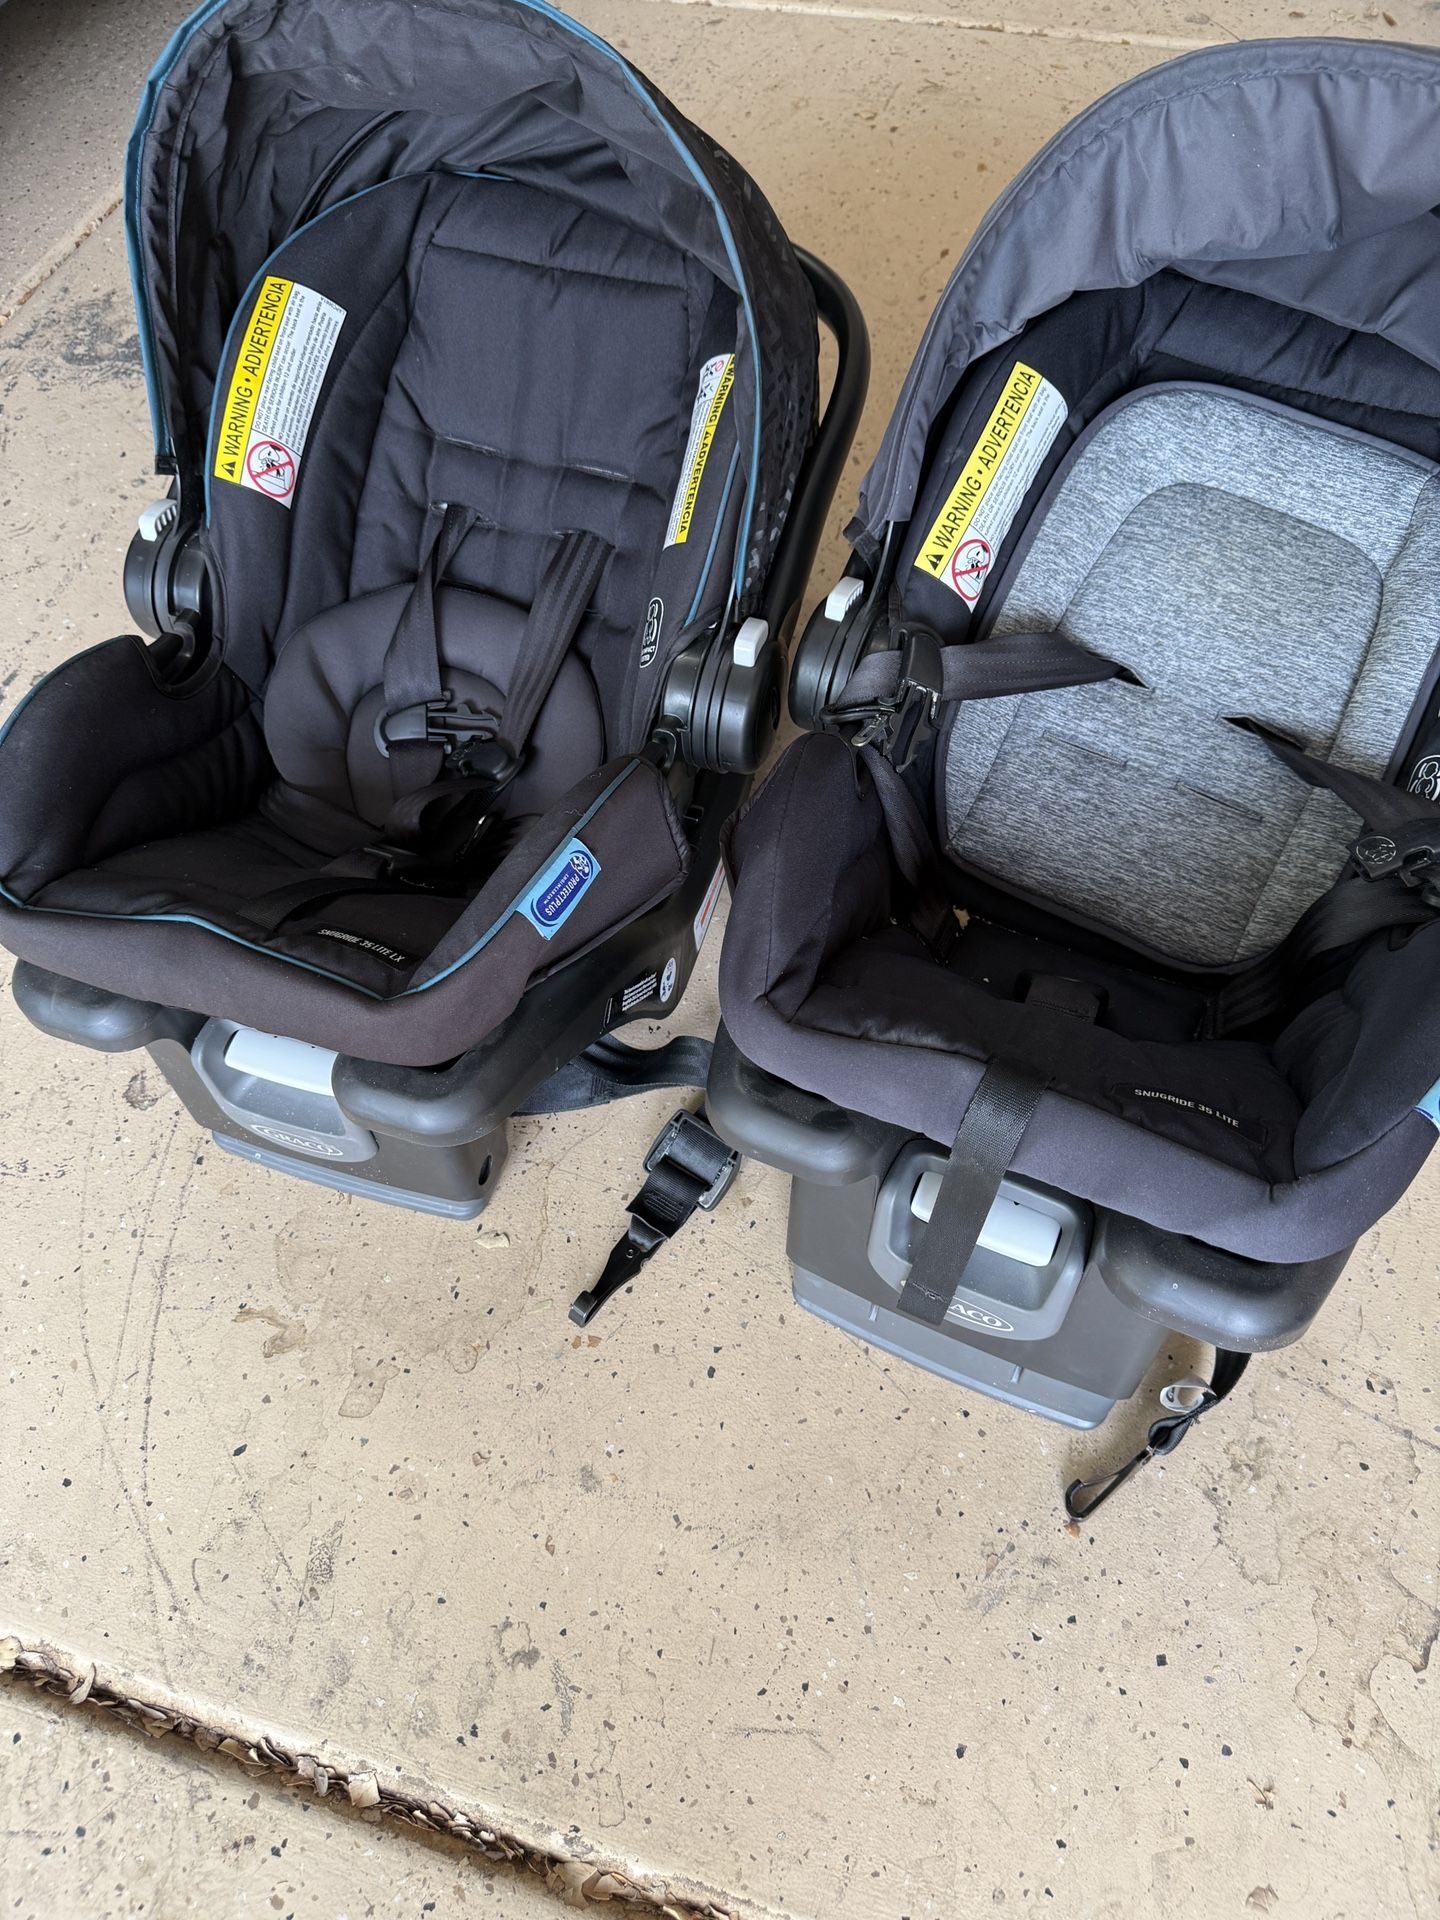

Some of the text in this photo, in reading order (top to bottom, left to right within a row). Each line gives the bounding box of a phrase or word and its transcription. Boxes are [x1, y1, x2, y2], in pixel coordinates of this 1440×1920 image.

[223, 281, 287, 457] WARNING ADVERTENCIA
[708, 366, 735, 423] WARNING
[932, 475, 982, 550] WARNING
[978, 370, 1036, 471] ADVERTENCIA
[679, 440, 712, 533] ADVERTENCIA
[545, 873, 580, 916] PROTECTPLUS
[317, 928, 406, 963] SNUGRIDE 35 LITE LX
[1134, 1088, 1240, 1128] SNUGRIDE 35 LITE
[262, 1127, 334, 1153] GRACO
[950, 1303, 1002, 1328] ACO
